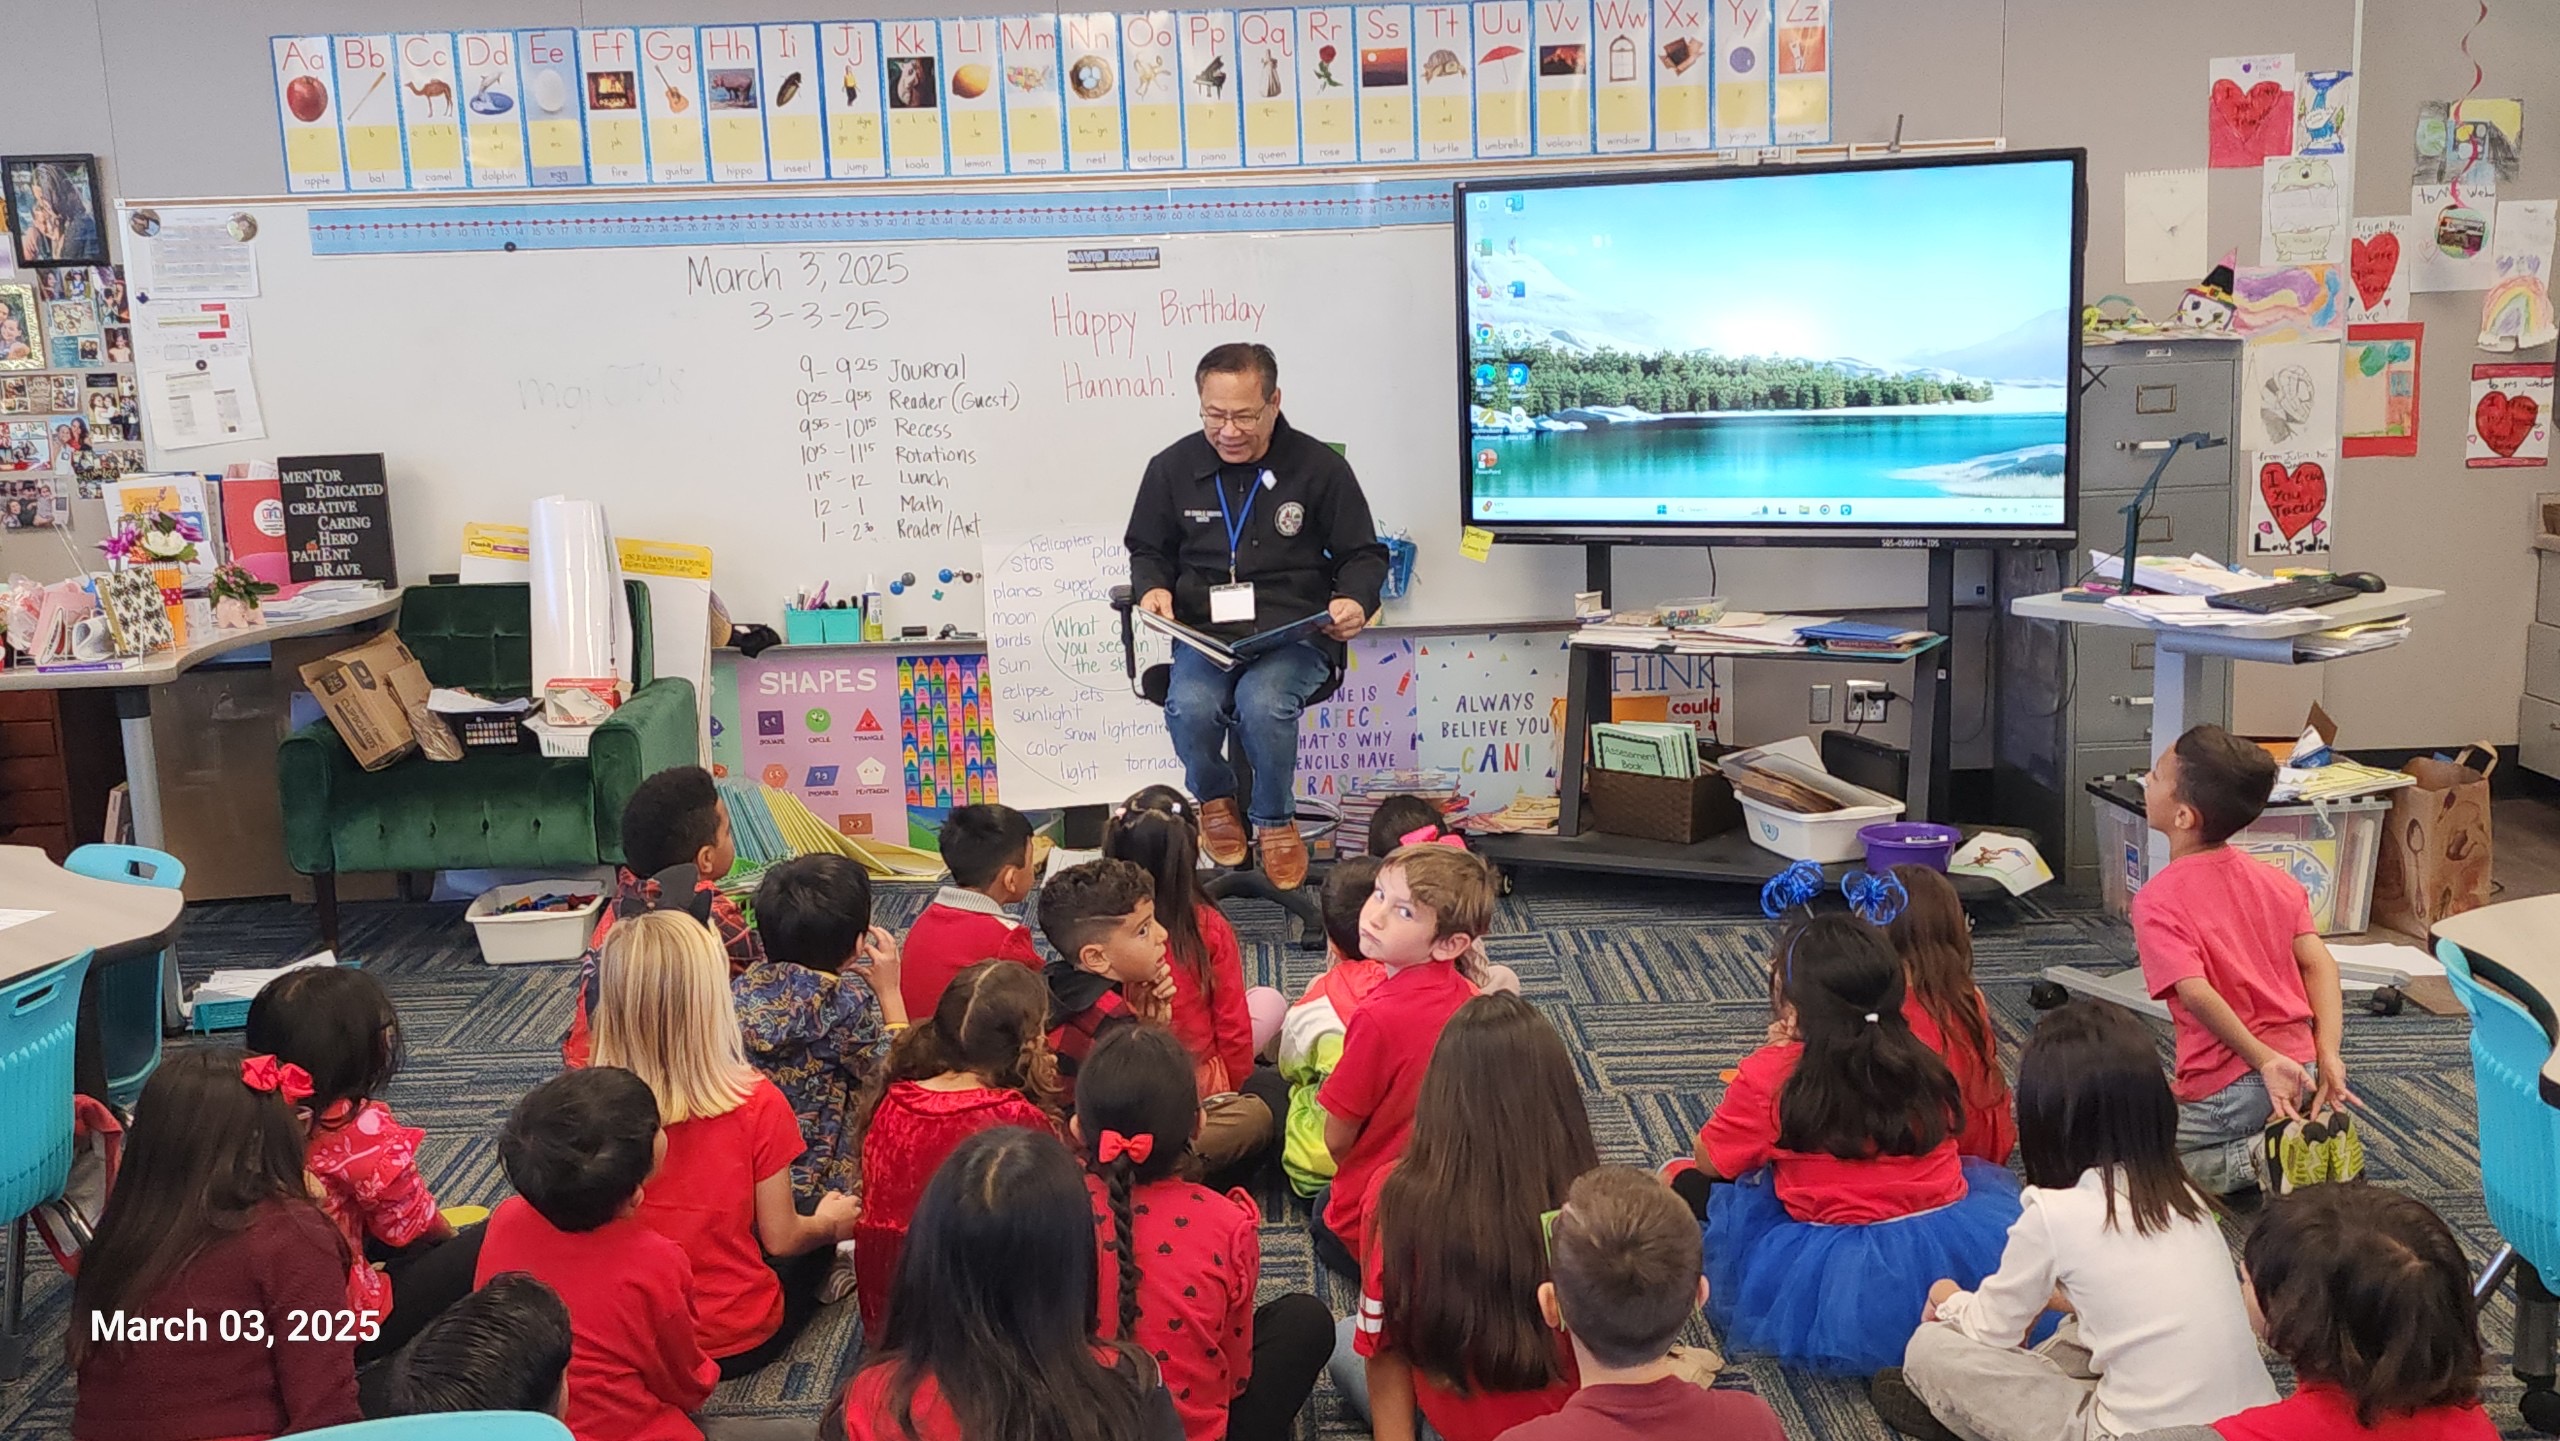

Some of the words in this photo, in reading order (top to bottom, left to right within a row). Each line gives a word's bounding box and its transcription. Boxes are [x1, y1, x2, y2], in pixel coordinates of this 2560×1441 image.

[1482, 6, 1521, 35] Uu
[1546, 4, 1579, 33] Vv
[1595, 0, 1646, 31] Ww
[1664, 0, 1700, 29] Xx
[1728, 0, 1758, 38] Yy
[1785, 0, 1819, 23] Zz
[1070, 19, 1109, 48] Nn
[1128, 17, 1171, 47] Oo
[1309, 12, 1342, 41] Rr
[1368, 10, 1398, 39] Ss
[1426, 8, 1458, 38] Tt
[778, 28, 796, 58] Ii
[896, 26, 926, 53] Kk
[1002, 20, 1054, 50] Mm
[1191, 16, 1225, 56] Pp
[1242, 15, 1292, 56] Qq
[282, 41, 324, 71] Aa
[345, 39, 384, 68] Bb
[404, 38, 447, 66] Cc
[466, 36, 508, 66] Dd
[530, 34, 563, 64] Ee
[592, 33, 627, 62] Ff
[646, 31, 692, 74] Gg
[709, 32, 750, 60] Hh
[834, 26, 862, 66] Jj
[1379, 146, 1396, 155] sun
[1433, 143, 1459, 153] turtle
[1484, 139, 1524, 150] umbrella
[1546, 138, 1582, 148] volcano
[1606, 134, 1640, 146] window
[964, 158, 992, 169] lemon
[1086, 154, 1106, 164] nest
[1137, 152, 1175, 164] octopus
[1200, 152, 1226, 163] piano
[1258, 150, 1286, 162] queen
[1319, 148, 1340, 158] rose
[610, 166, 628, 178] fire
[665, 165, 694, 177] guitar
[726, 164, 752, 177] hippo
[783, 162, 812, 173] insect
[844, 162, 869, 174] jump
[905, 158, 930, 170] koala
[304, 175, 330, 188] apple
[482, 170, 517, 182] dolphin
[688, 251, 782, 296] March
[799, 250, 827, 293] 3,
[838, 252, 909, 287] 2025
[1052, 291, 1136, 360] Happy
[1159, 288, 1266, 333] Birthday
[1062, 350, 1176, 404] Hannah!
[889, 389, 947, 410] Reader
[894, 417, 952, 440] Recess
[896, 445, 977, 465] Rotations
[899, 470, 950, 490] Lunch
[289, 500, 358, 516] CREATIVE
[900, 495, 944, 514] Math
[317, 516, 372, 530] CARING
[318, 532, 358, 547] HERO
[1029, 534, 1096, 554] helicopters
[993, 583, 1043, 608] planes
[992, 612, 1036, 626] moon
[1052, 616, 1098, 639] What
[1111, 619, 1146, 636] cn
[996, 632, 1032, 648] birds
[1057, 640, 1088, 664] you
[1135, 640, 1150, 653] in
[1076, 656, 1100, 674] the
[759, 668, 878, 696] SHAPES
[1002, 684, 1054, 700] eclipse
[1362, 686, 1378, 702] IS
[1456, 692, 1535, 714] ALWAYS
[1672, 697, 1720, 714] could
[1013, 704, 1083, 730] sunlight
[1441, 720, 1508, 739] BELIEVE
[1516, 716, 1550, 736] YOU
[1064, 728, 1097, 742] snow
[1356, 730, 1392, 748] WHY
[1026, 740, 1069, 757] color
[1461, 742, 1532, 775] CAN!
[1358, 752, 1396, 768] HAVE
[1621, 759, 1645, 772] Book
[1060, 760, 1098, 786] light
